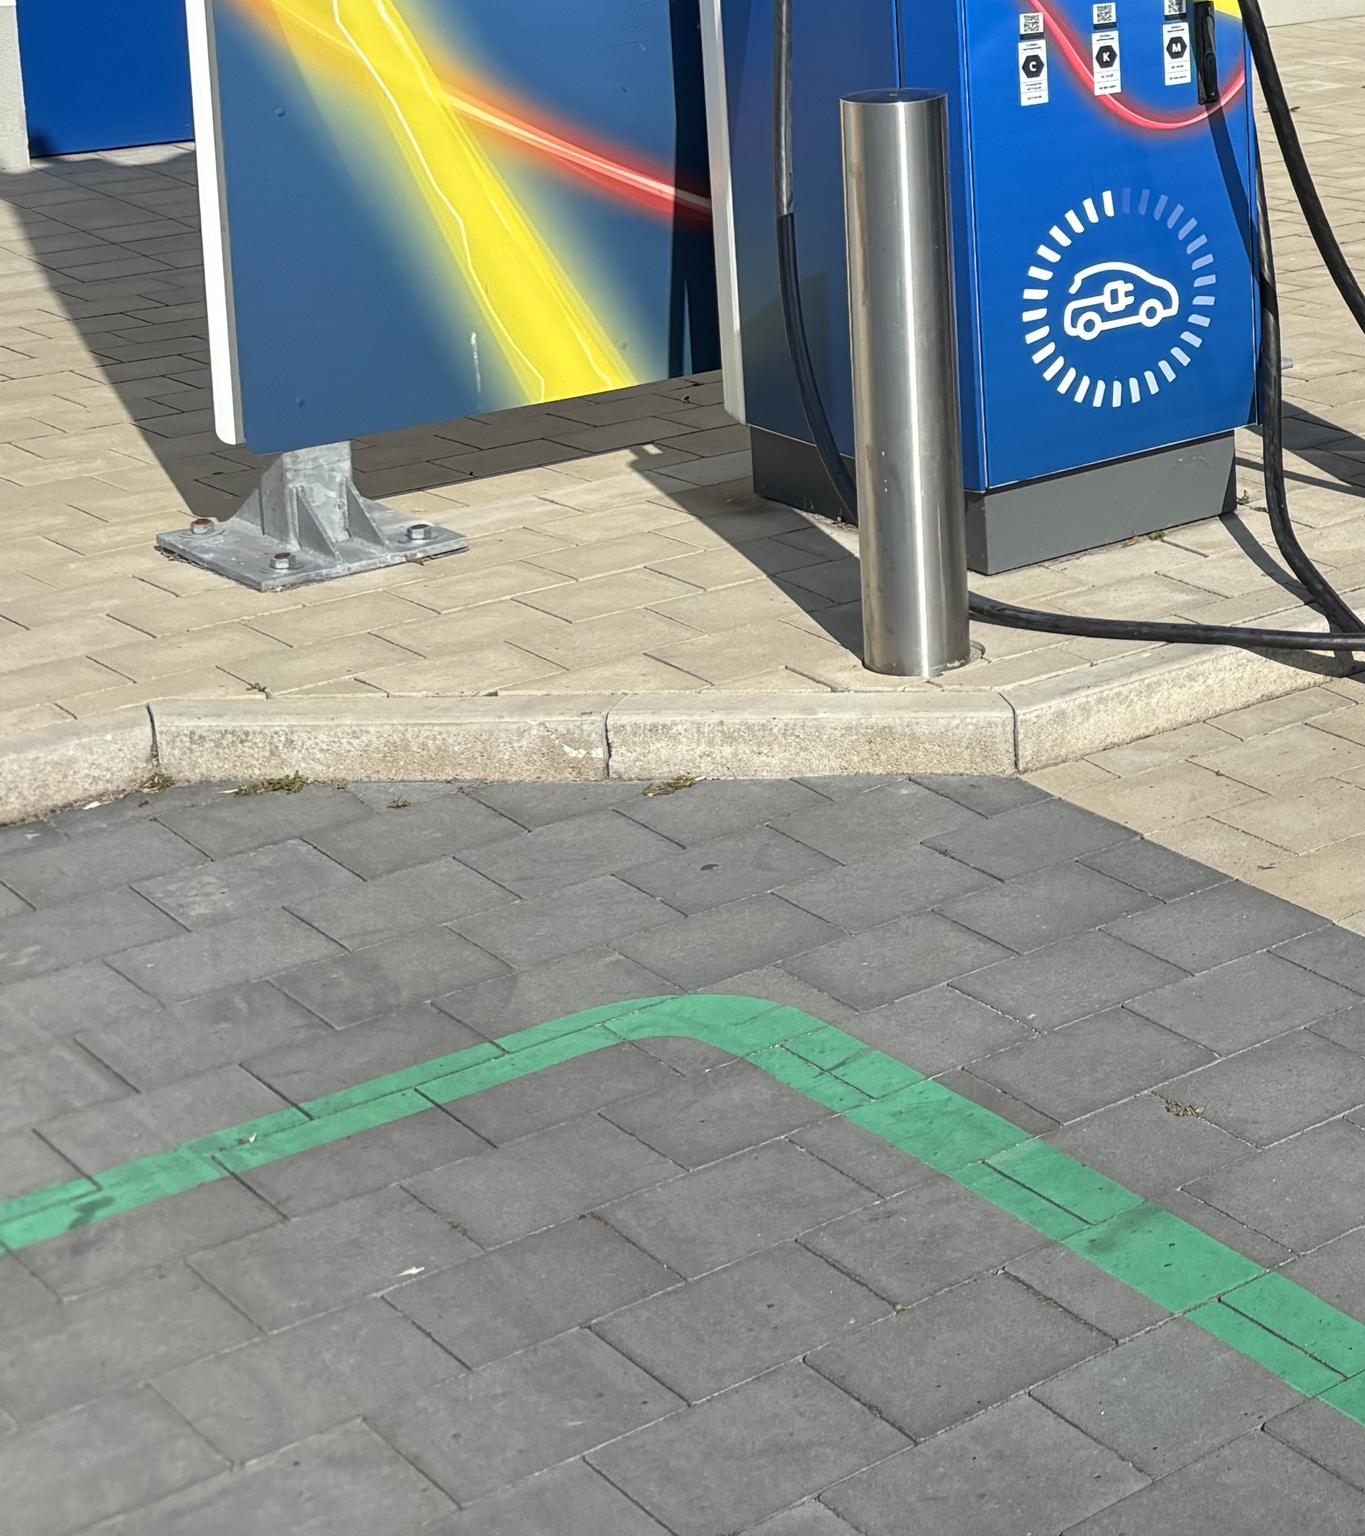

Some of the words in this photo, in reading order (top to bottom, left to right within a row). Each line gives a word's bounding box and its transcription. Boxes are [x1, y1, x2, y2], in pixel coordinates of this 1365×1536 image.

[1172, 42, 1182, 53] M
[1102, 51, 1111, 62] K
[1029, 61, 1037, 72] C
